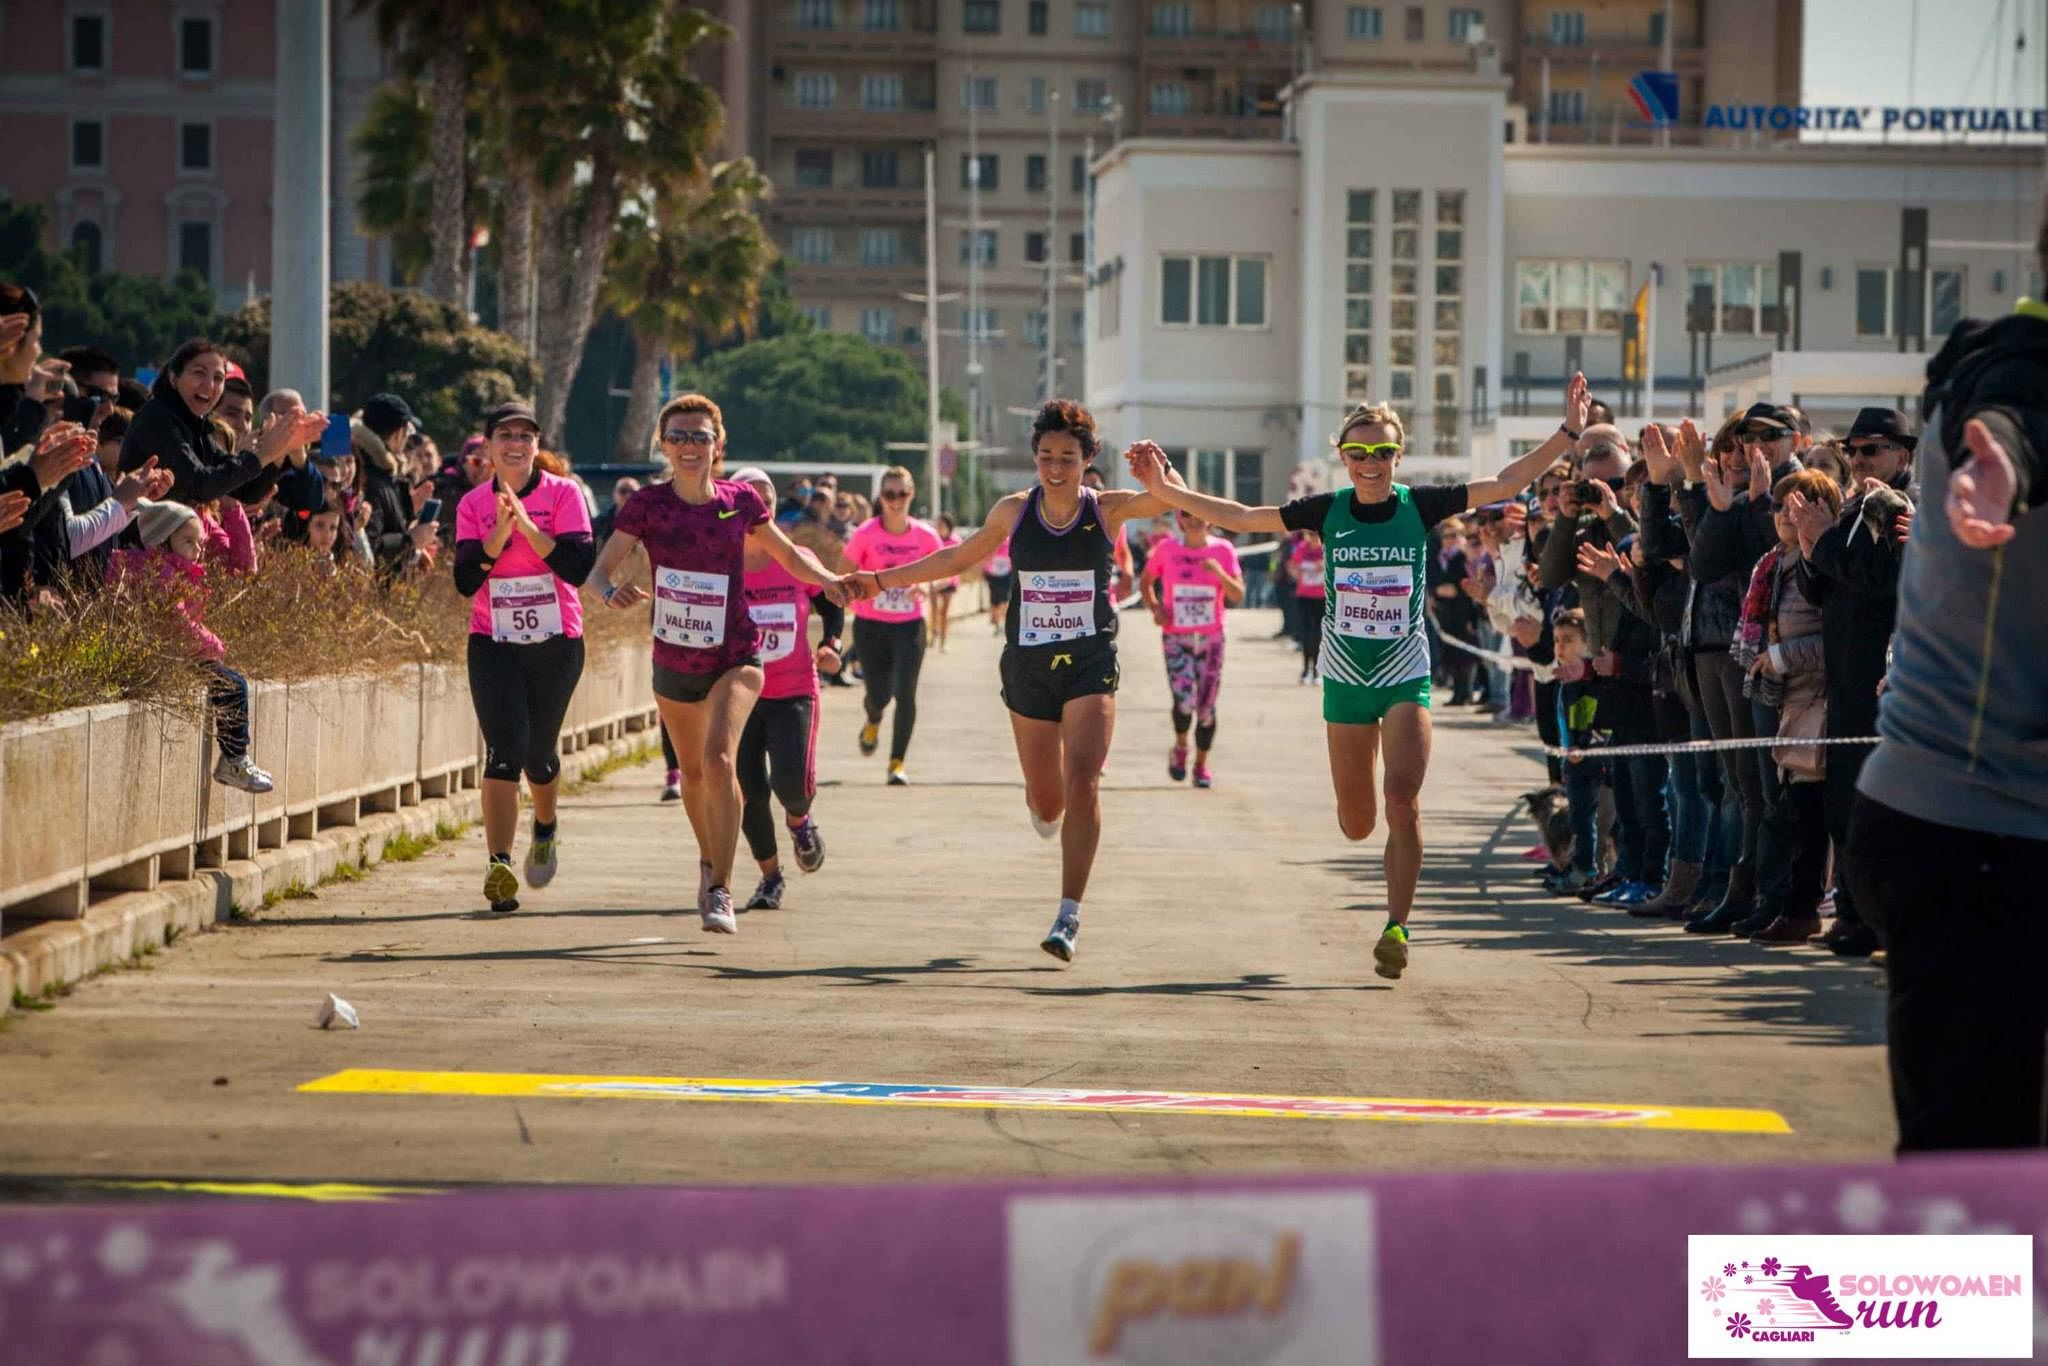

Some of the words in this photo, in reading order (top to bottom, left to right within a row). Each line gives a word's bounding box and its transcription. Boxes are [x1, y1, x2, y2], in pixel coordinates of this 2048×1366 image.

[1882, 106, 2046, 132] PORTUALE
[1332, 547, 1417, 563] FORESTALE
[1371, 596, 1378, 608] 2
[685, 606, 691, 618] 1
[1054, 605, 1061, 617] 3
[1344, 605, 1402, 621] DEBORAH
[512, 609, 539, 631] 56
[665, 613, 713, 632] VALERIA
[1032, 616, 1084, 629] CLAUDIA
